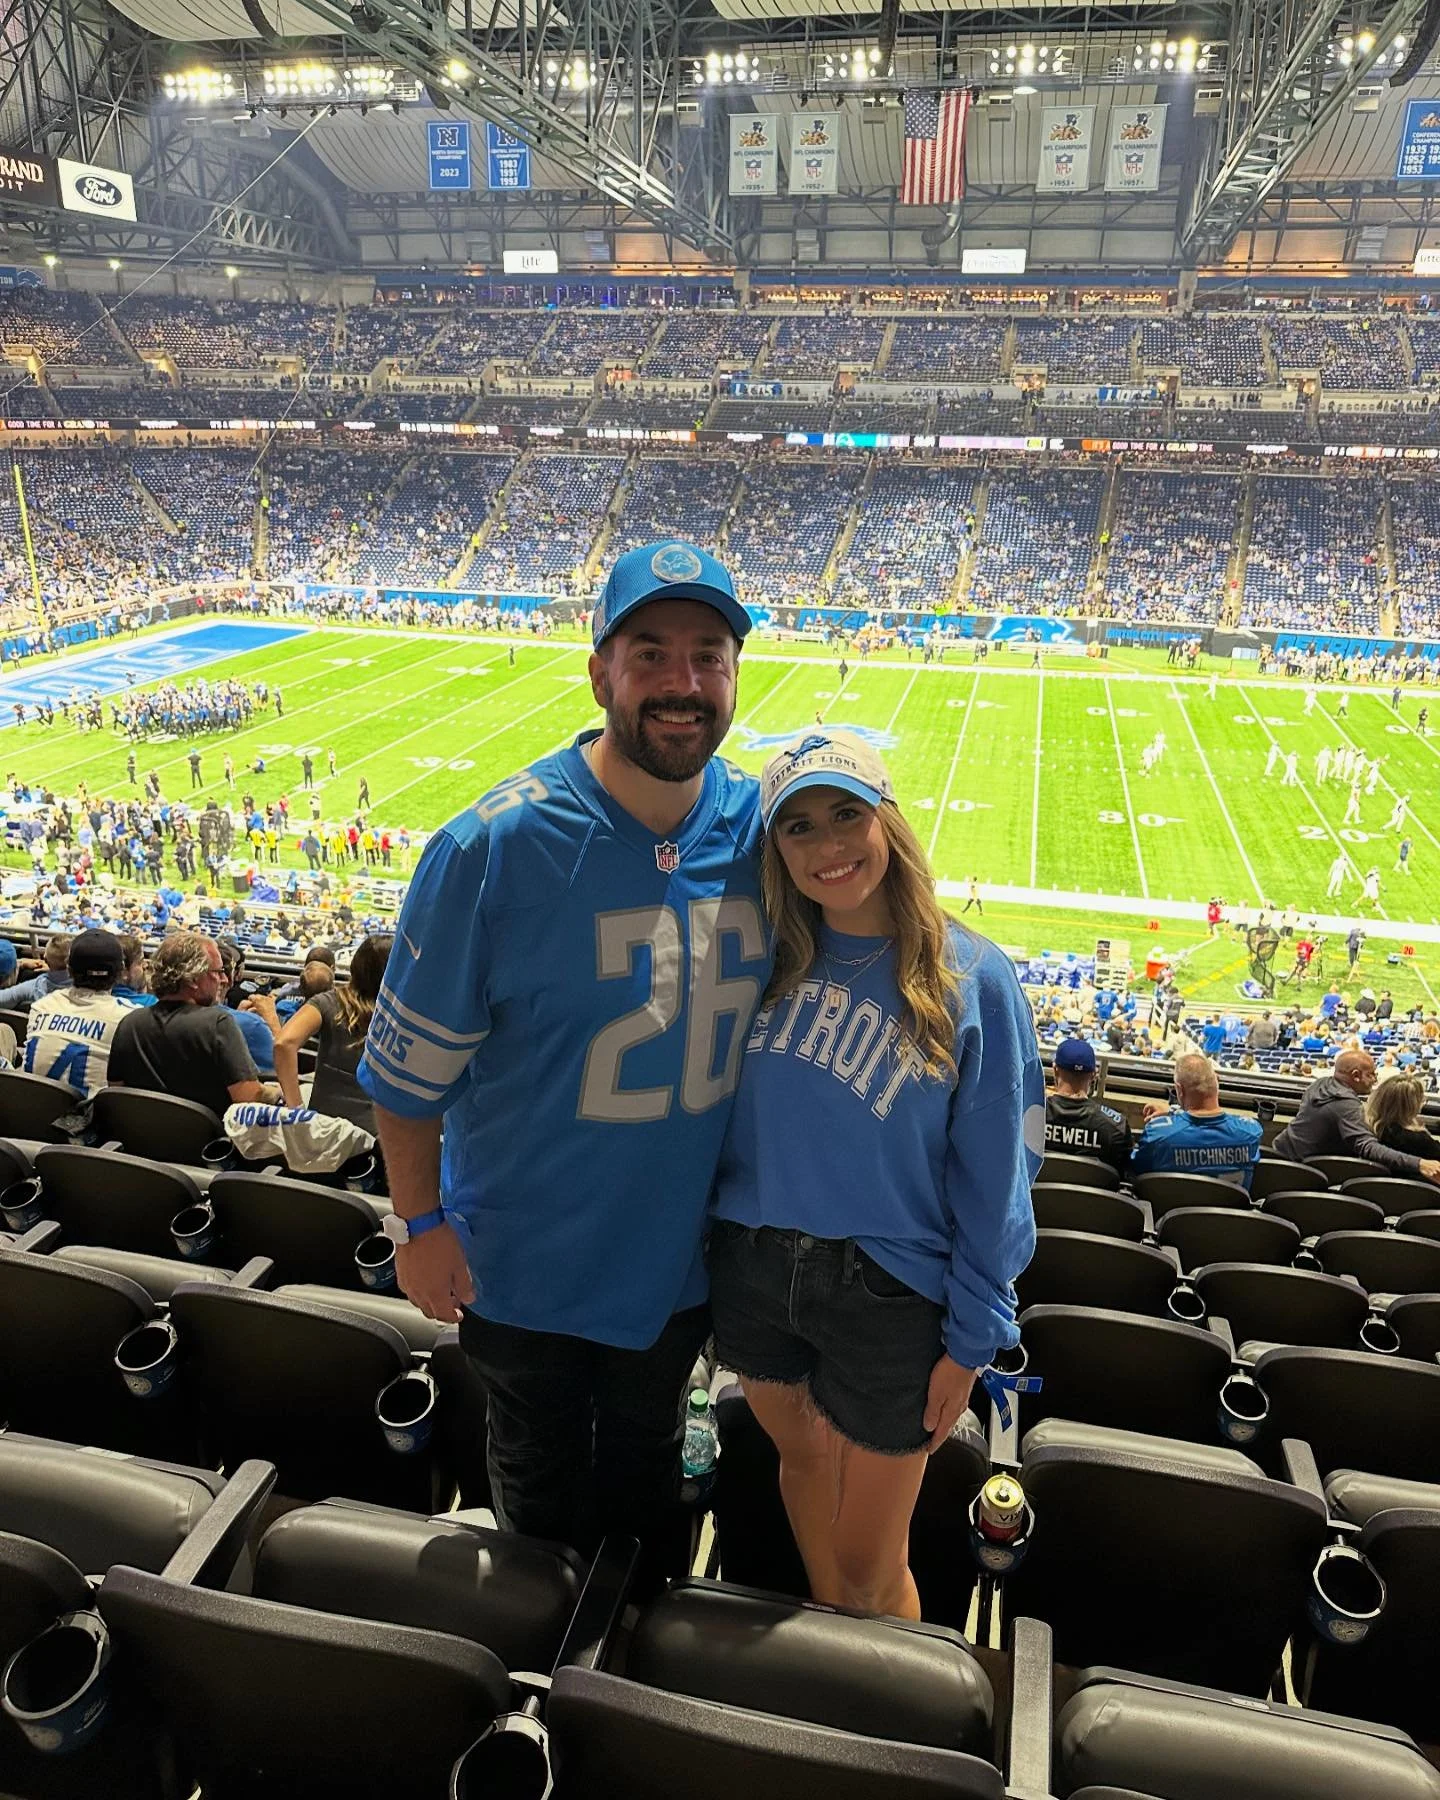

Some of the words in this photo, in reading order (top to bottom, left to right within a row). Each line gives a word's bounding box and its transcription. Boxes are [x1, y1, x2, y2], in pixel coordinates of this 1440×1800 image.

[440, 168, 459, 177] 2023
[83, 177, 116, 204] Ford
[576, 897, 768, 1124] 26
[32, 1014, 49, 1031] ST
[48, 1014, 107, 1041] BROWN
[1045, 1123, 1102, 1149] SEWELL
[1174, 1145, 1250, 1168] HUTCHINSON
